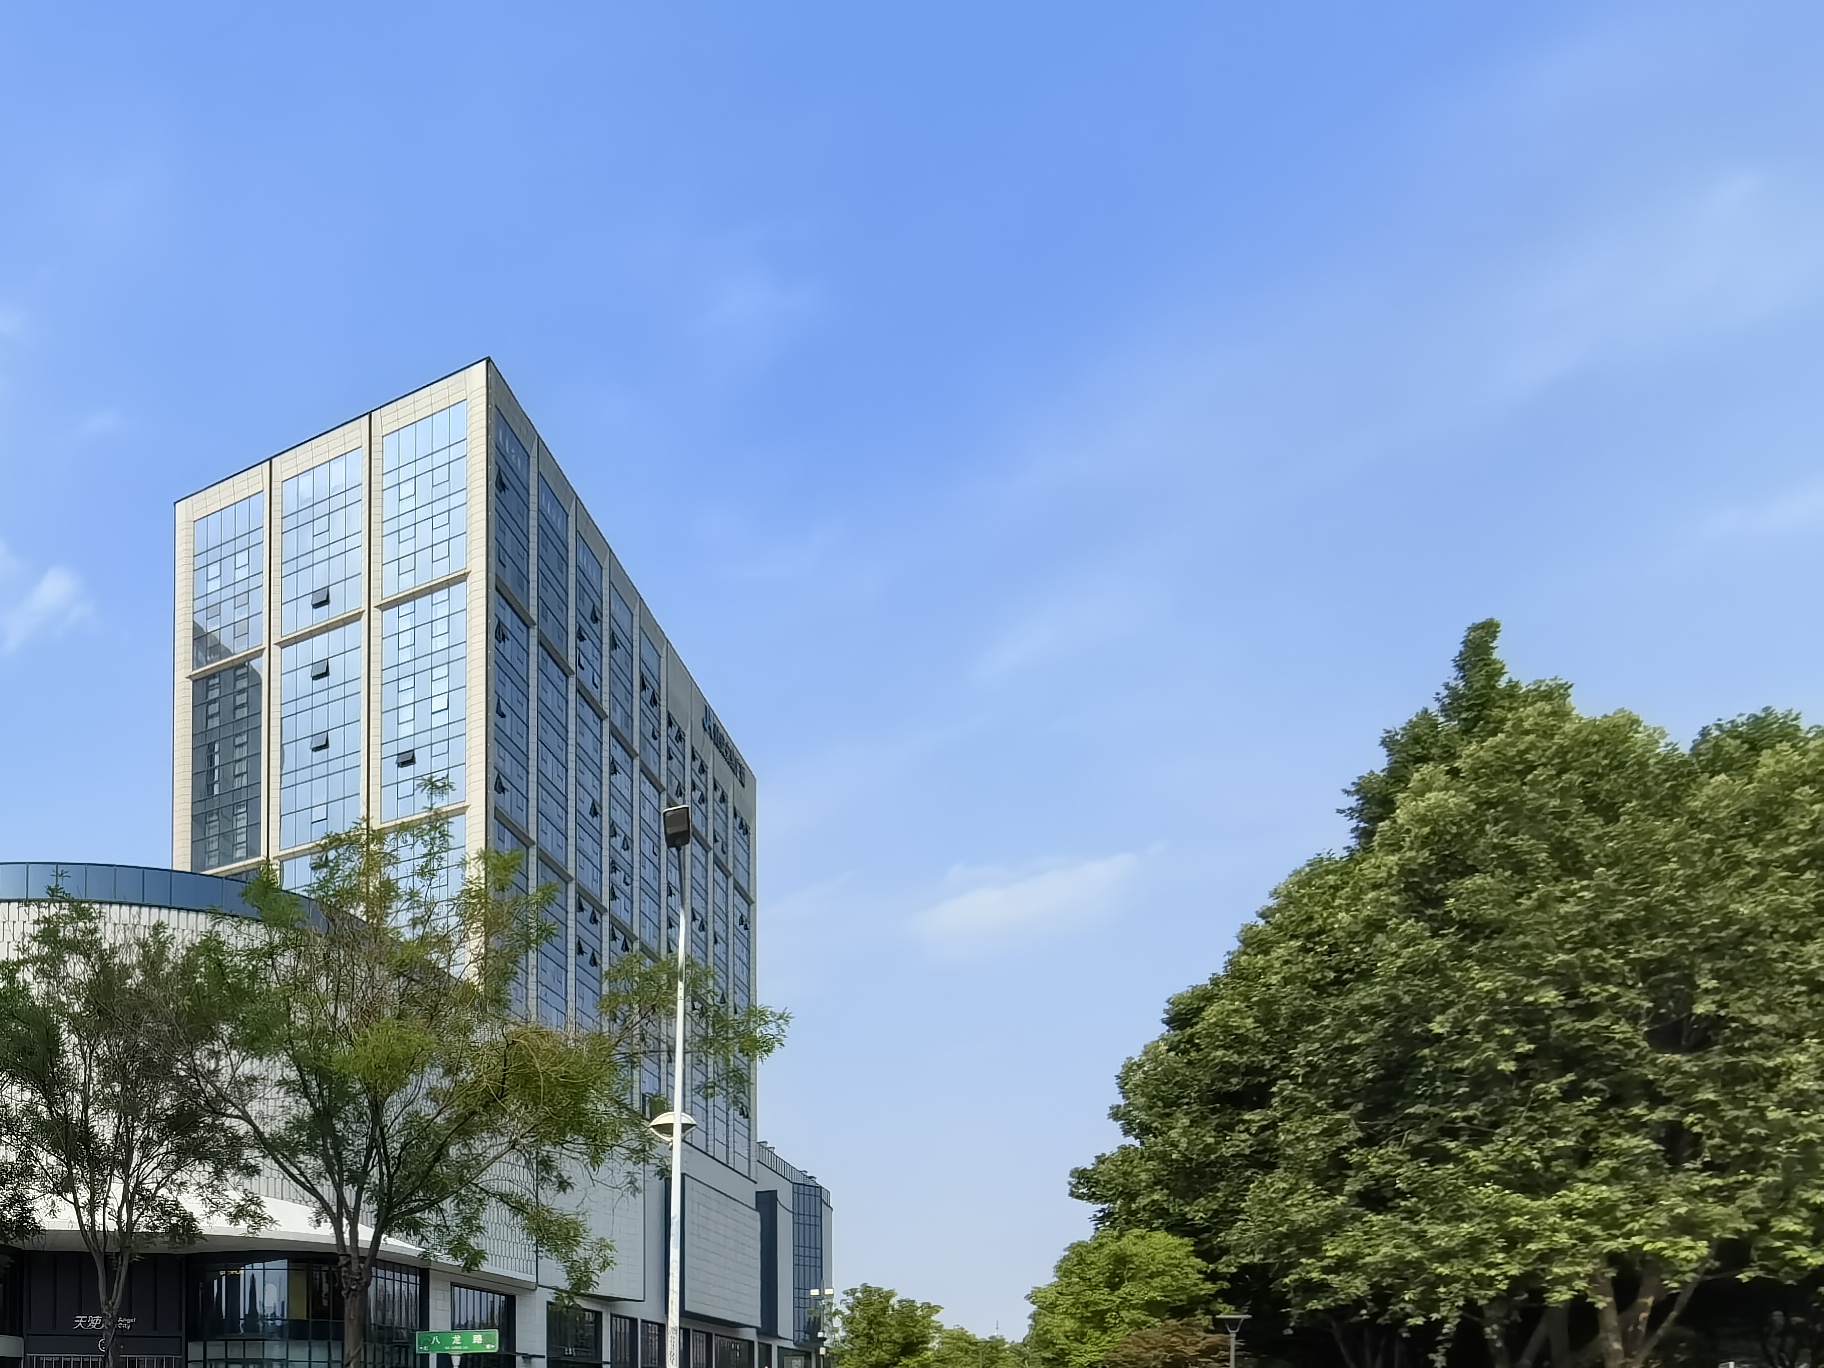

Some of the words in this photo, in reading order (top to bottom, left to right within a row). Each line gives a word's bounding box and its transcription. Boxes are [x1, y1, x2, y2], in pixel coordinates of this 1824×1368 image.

[72, 1315, 110, 1330] 天使
[117, 1316, 136, 1324] Angel
[431, 1334, 484, 1344] 八龙路
